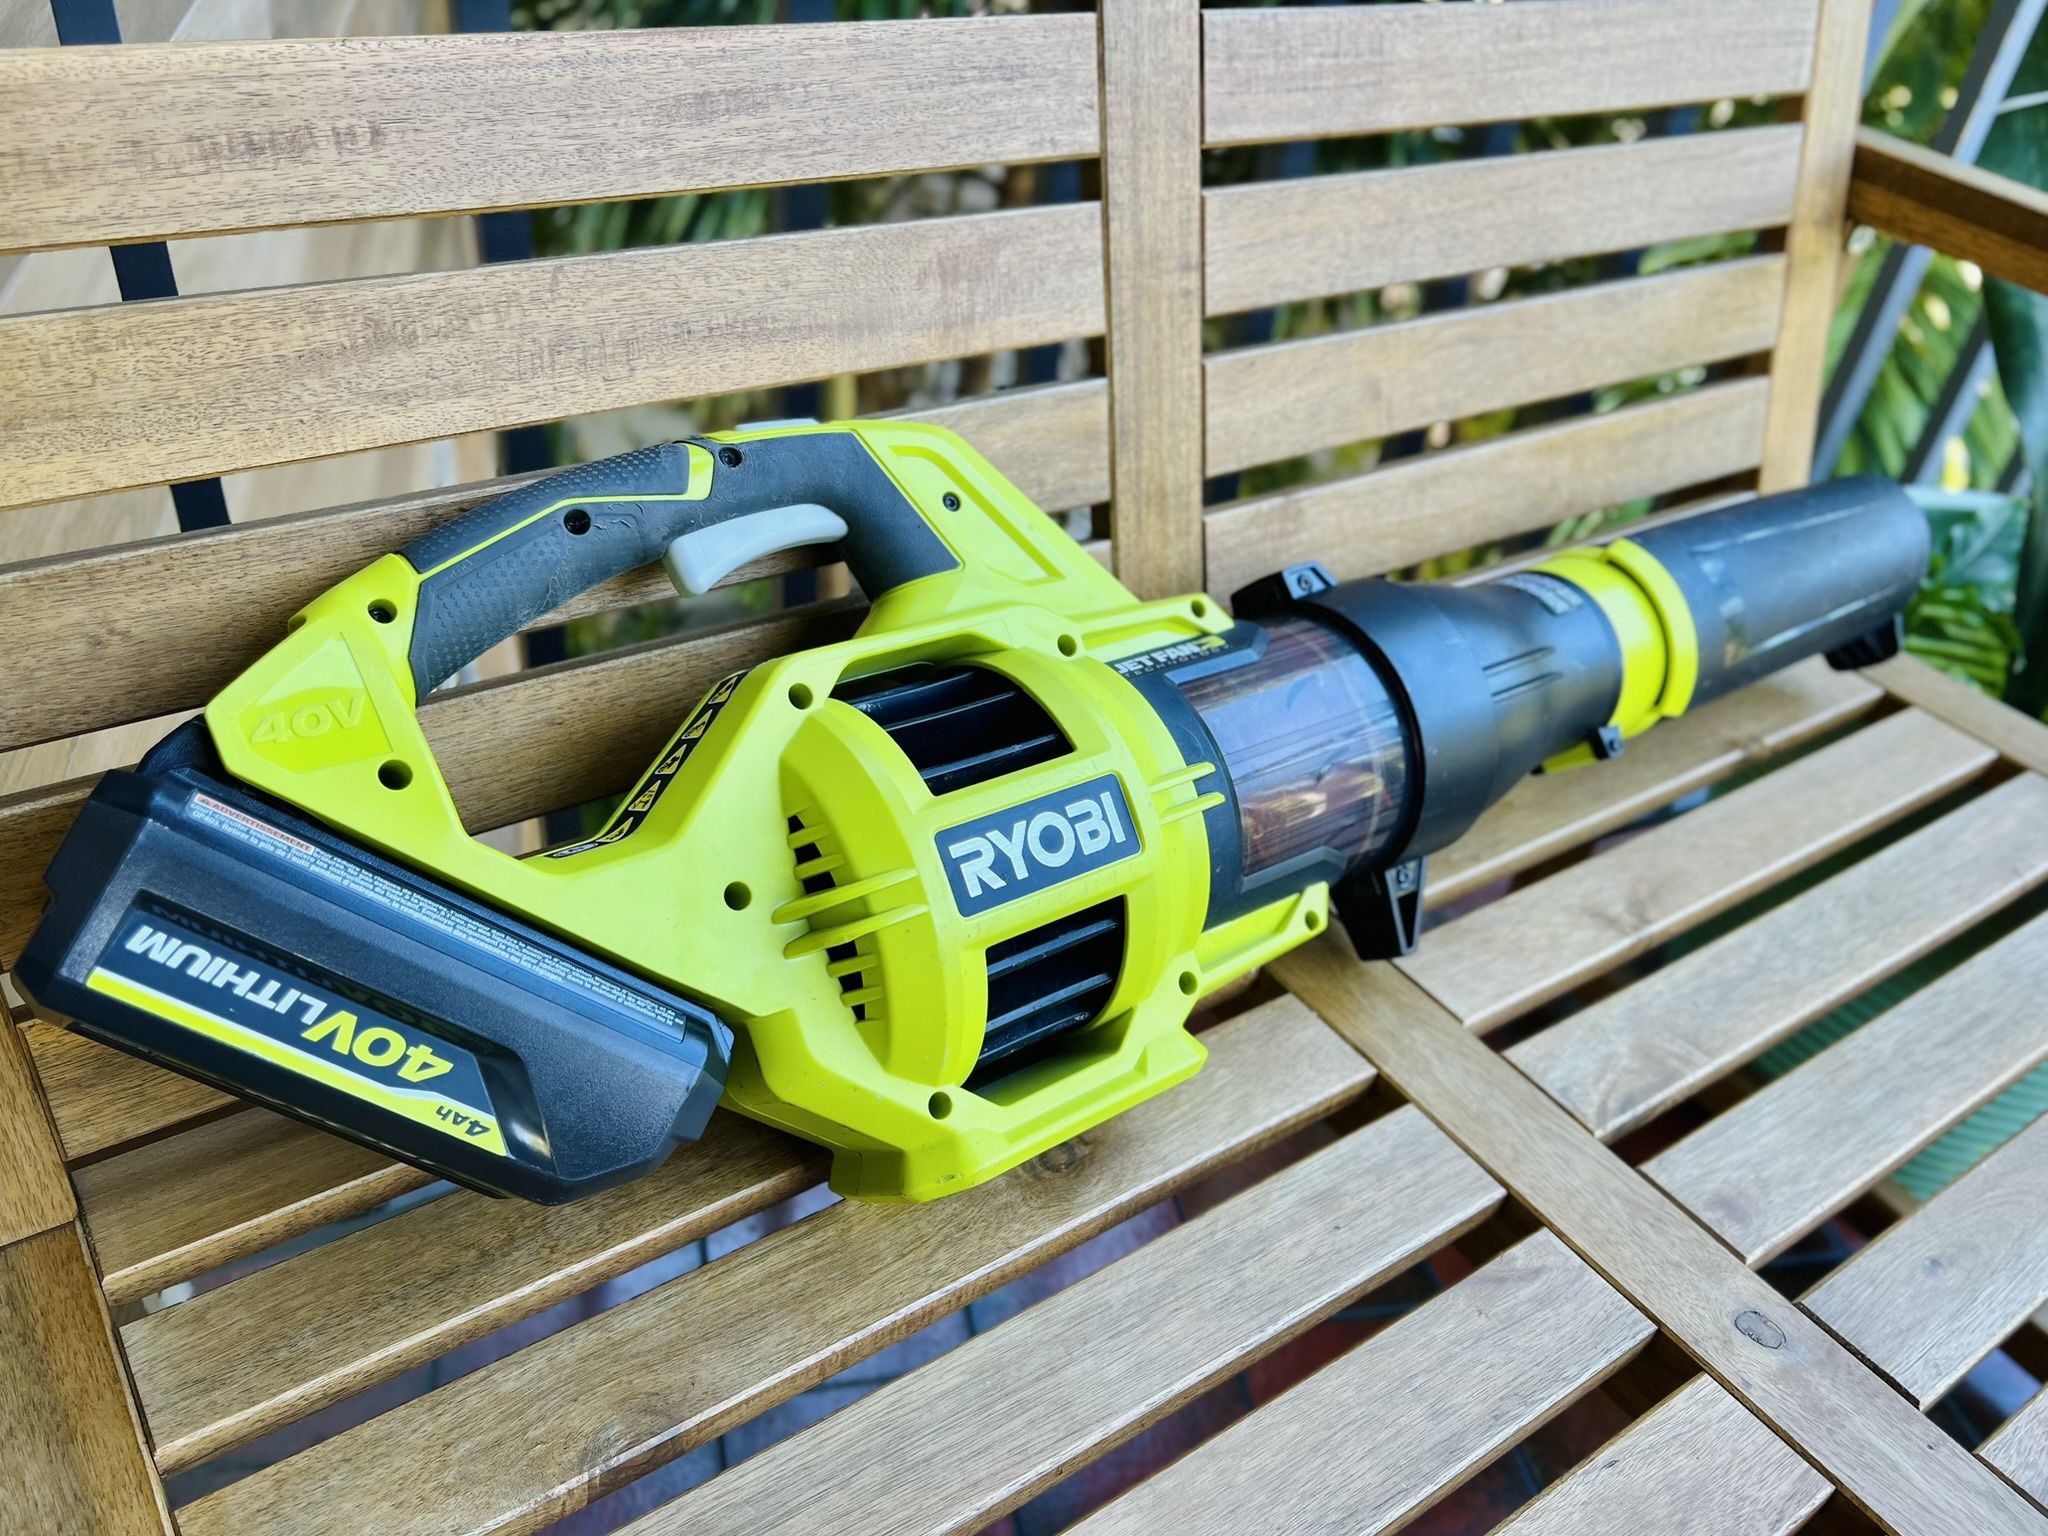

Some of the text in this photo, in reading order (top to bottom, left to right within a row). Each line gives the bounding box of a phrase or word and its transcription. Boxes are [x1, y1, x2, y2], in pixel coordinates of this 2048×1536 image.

[1113, 641, 1201, 674] JET FAN
[250, 693, 367, 745] 40V
[949, 791, 1126, 898] RYOBI
[124, 924, 327, 1026] LITHIUM
[435, 1104, 491, 1138] 4Ah
